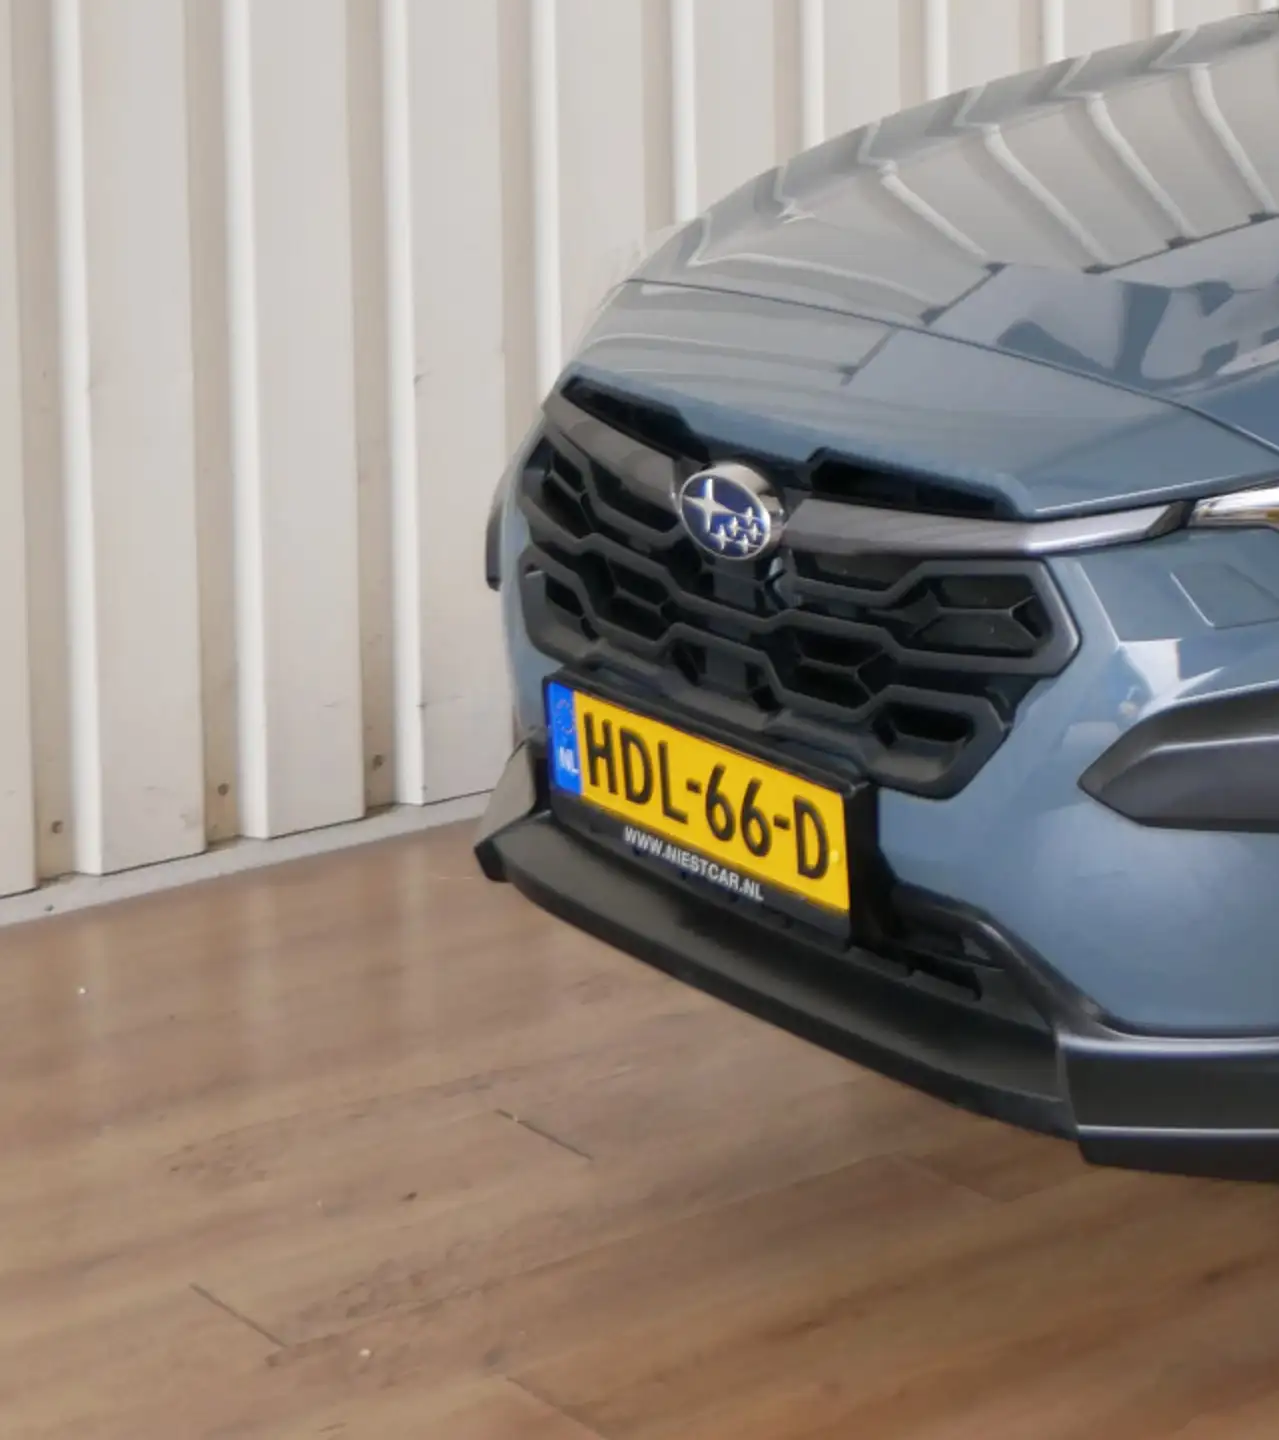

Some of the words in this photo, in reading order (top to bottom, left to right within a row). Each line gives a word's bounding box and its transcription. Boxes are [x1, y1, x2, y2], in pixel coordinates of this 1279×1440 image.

[558, 746, 580, 775] NL
[583, 712, 829, 880] HDL-66-D
[623, 825, 765, 902] WWW.NIESTCAR.NL
